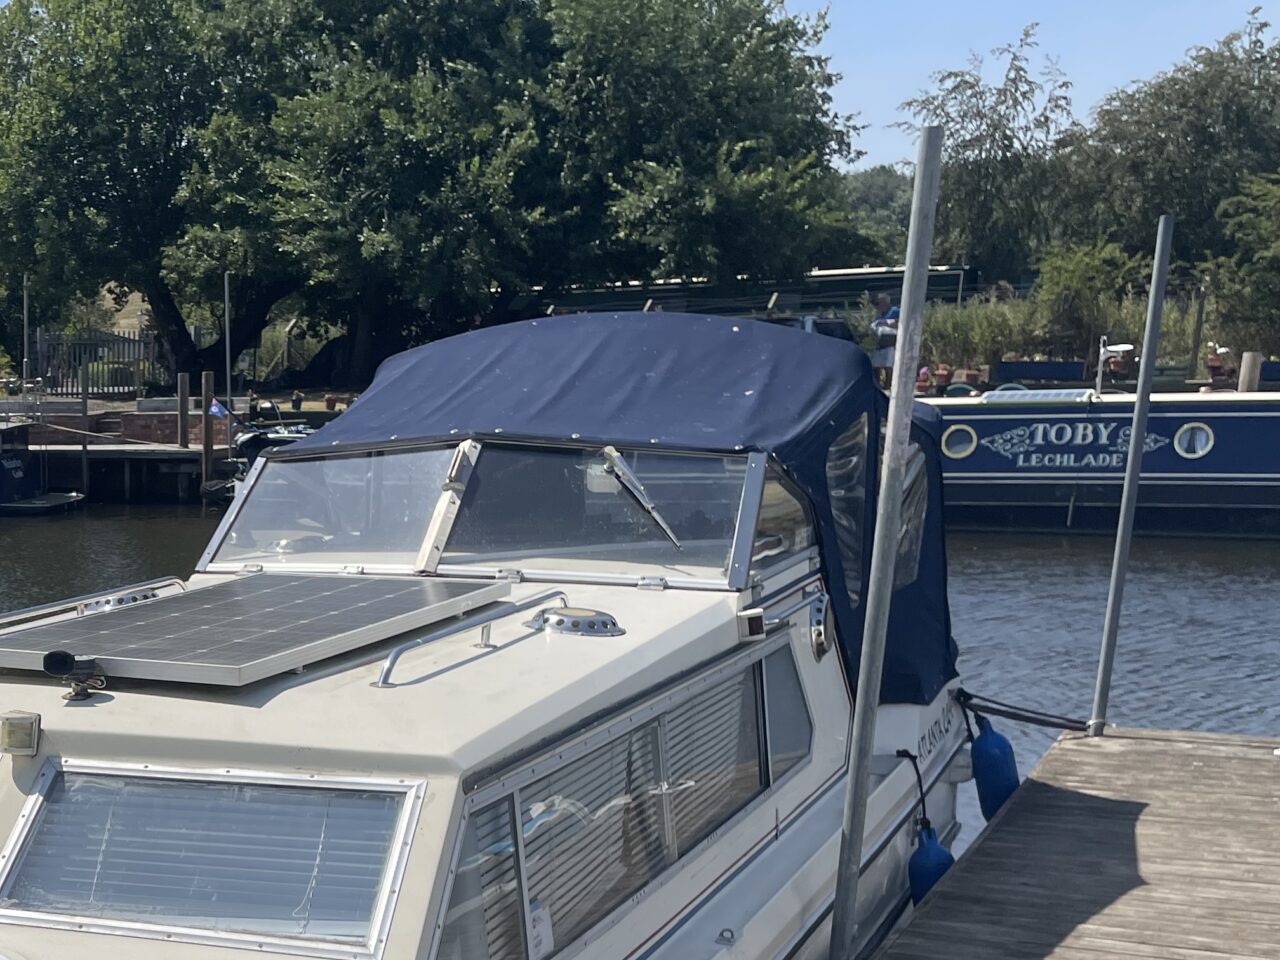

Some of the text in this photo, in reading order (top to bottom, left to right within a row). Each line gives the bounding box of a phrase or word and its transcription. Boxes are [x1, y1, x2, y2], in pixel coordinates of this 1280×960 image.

[1029, 422, 1118, 445] TOBY
[1016, 453, 1124, 467] LECHLADE
[917, 717, 944, 764] ATLANTA
